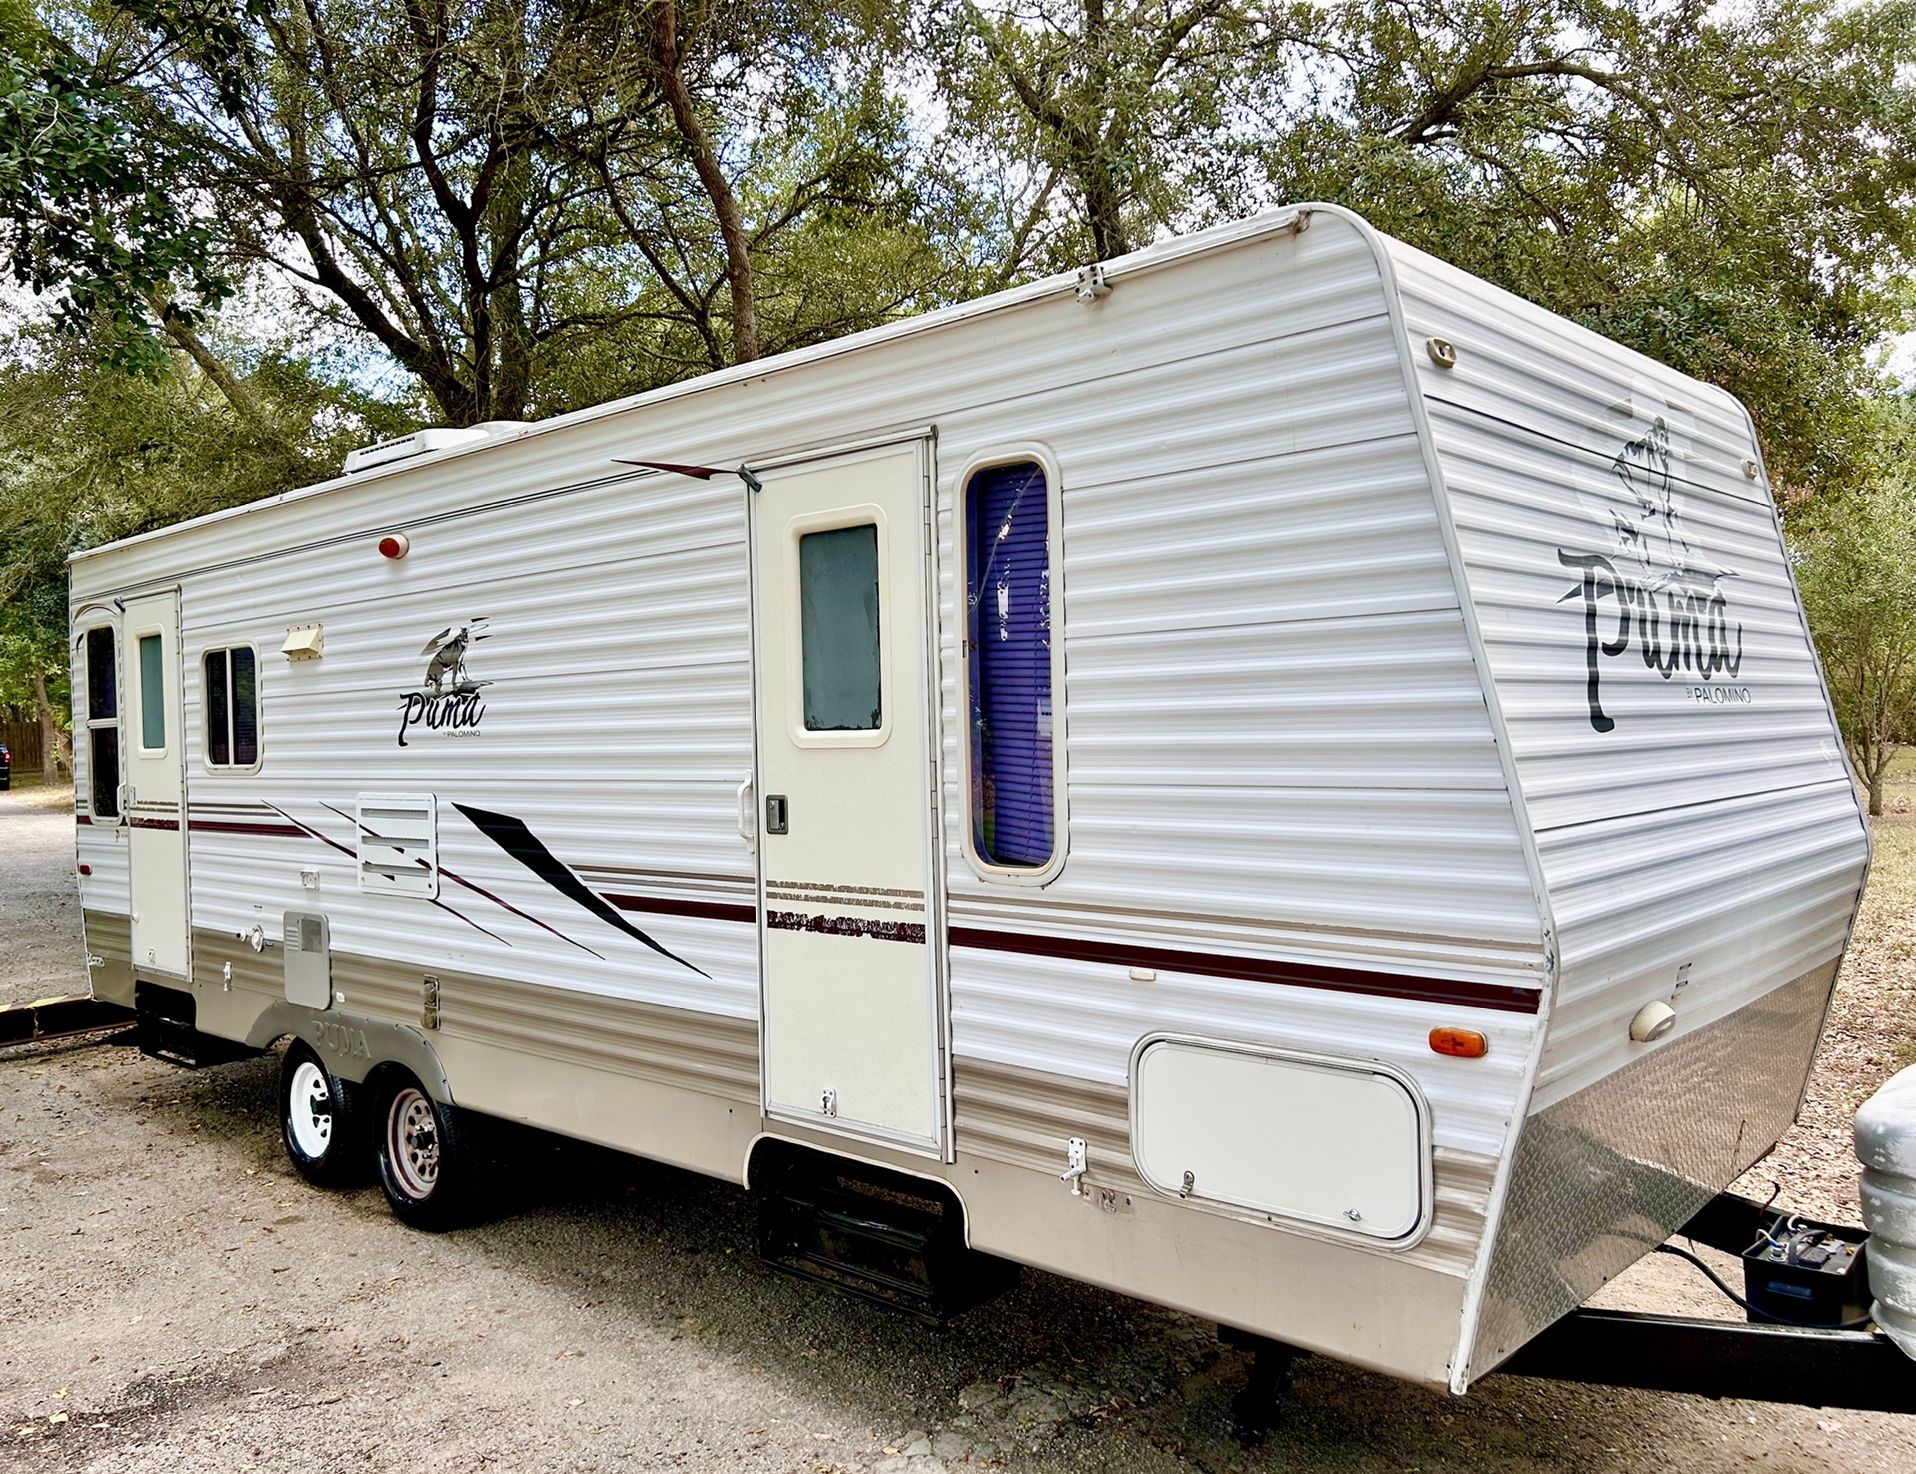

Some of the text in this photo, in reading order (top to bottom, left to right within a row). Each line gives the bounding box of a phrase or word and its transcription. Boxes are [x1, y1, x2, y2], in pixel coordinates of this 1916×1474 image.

[1557, 548, 1742, 734] Puma
[398, 691, 487, 747] Puma
[1694, 687, 1752, 704] PALOMINO
[311, 1019, 372, 1061] PUMA
